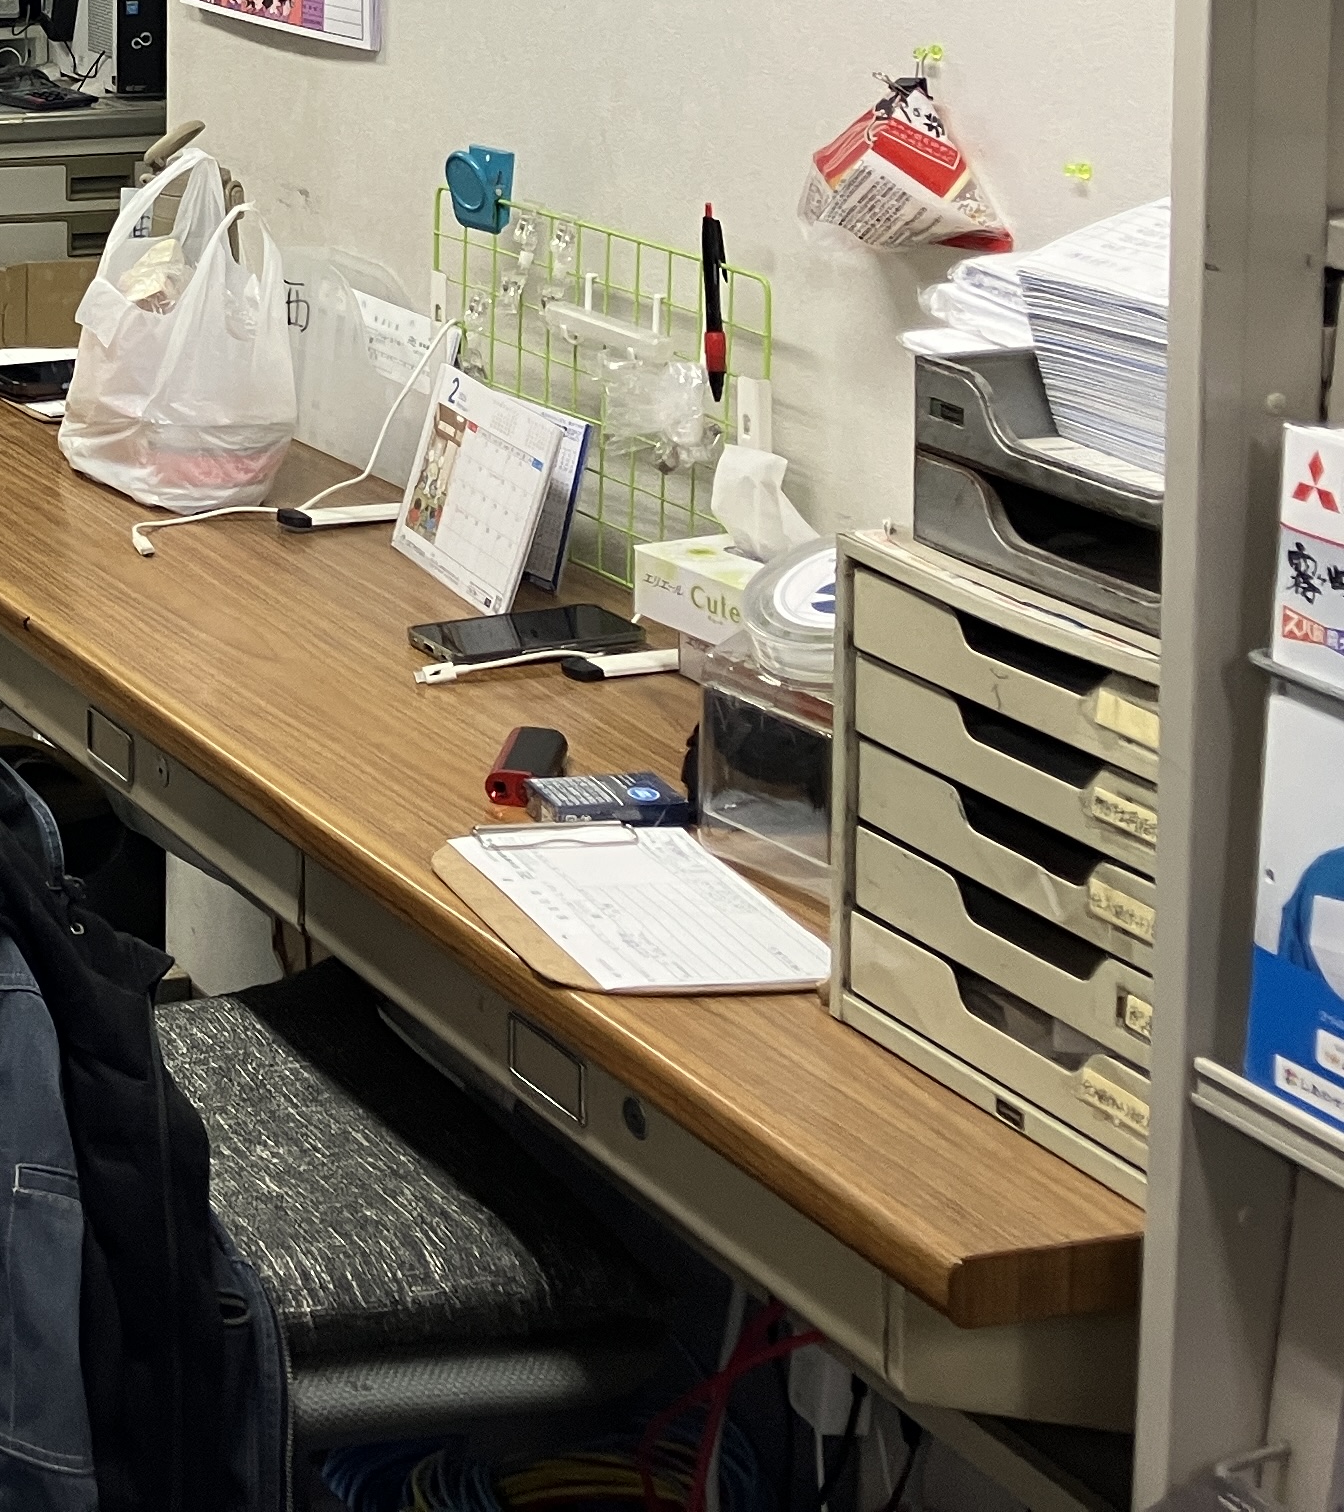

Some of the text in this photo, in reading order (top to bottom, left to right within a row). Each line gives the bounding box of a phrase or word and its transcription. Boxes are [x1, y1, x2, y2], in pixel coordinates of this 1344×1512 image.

[448, 376, 461, 404] 2
[642, 573, 685, 596] エリエール
[691, 585, 741, 624] Cute
